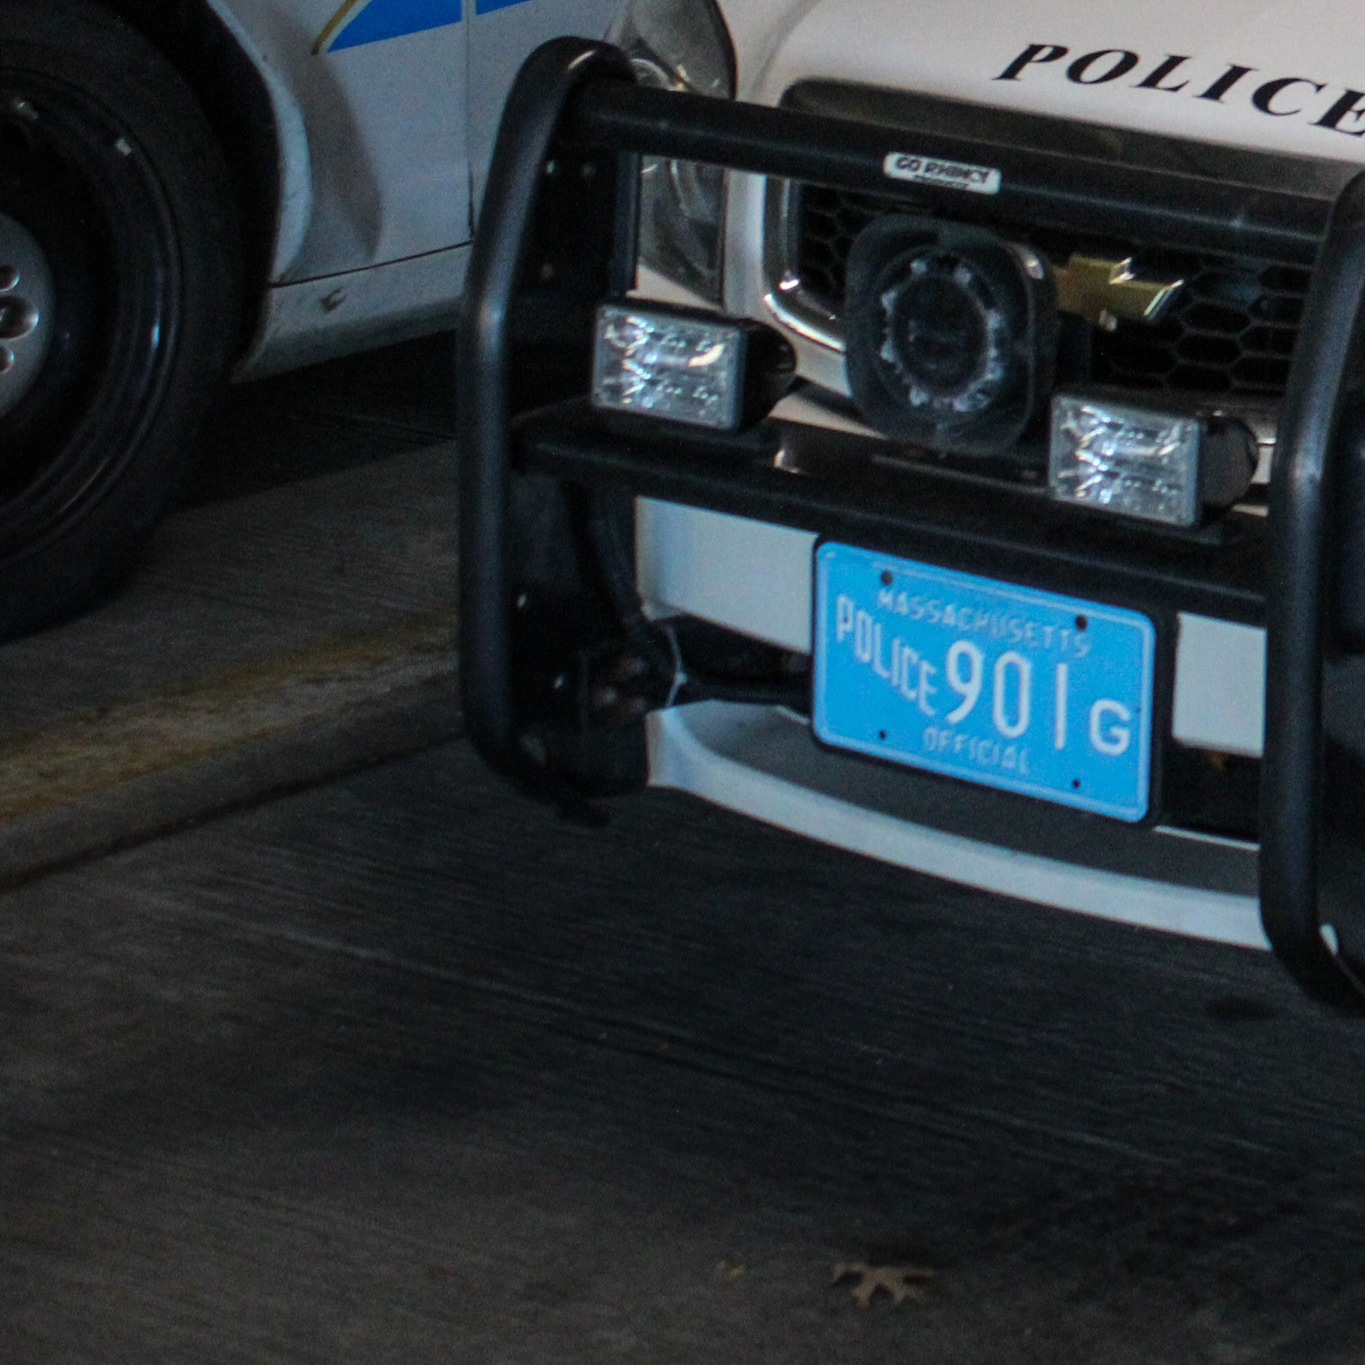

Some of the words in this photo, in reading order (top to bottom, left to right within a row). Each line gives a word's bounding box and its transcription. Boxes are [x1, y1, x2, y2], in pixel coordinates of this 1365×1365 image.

[836, 593, 937, 717] POLICE
[877, 588, 1092, 657] MASSACHUSETTS
[922, 727, 1029, 774] OFFICIAL
